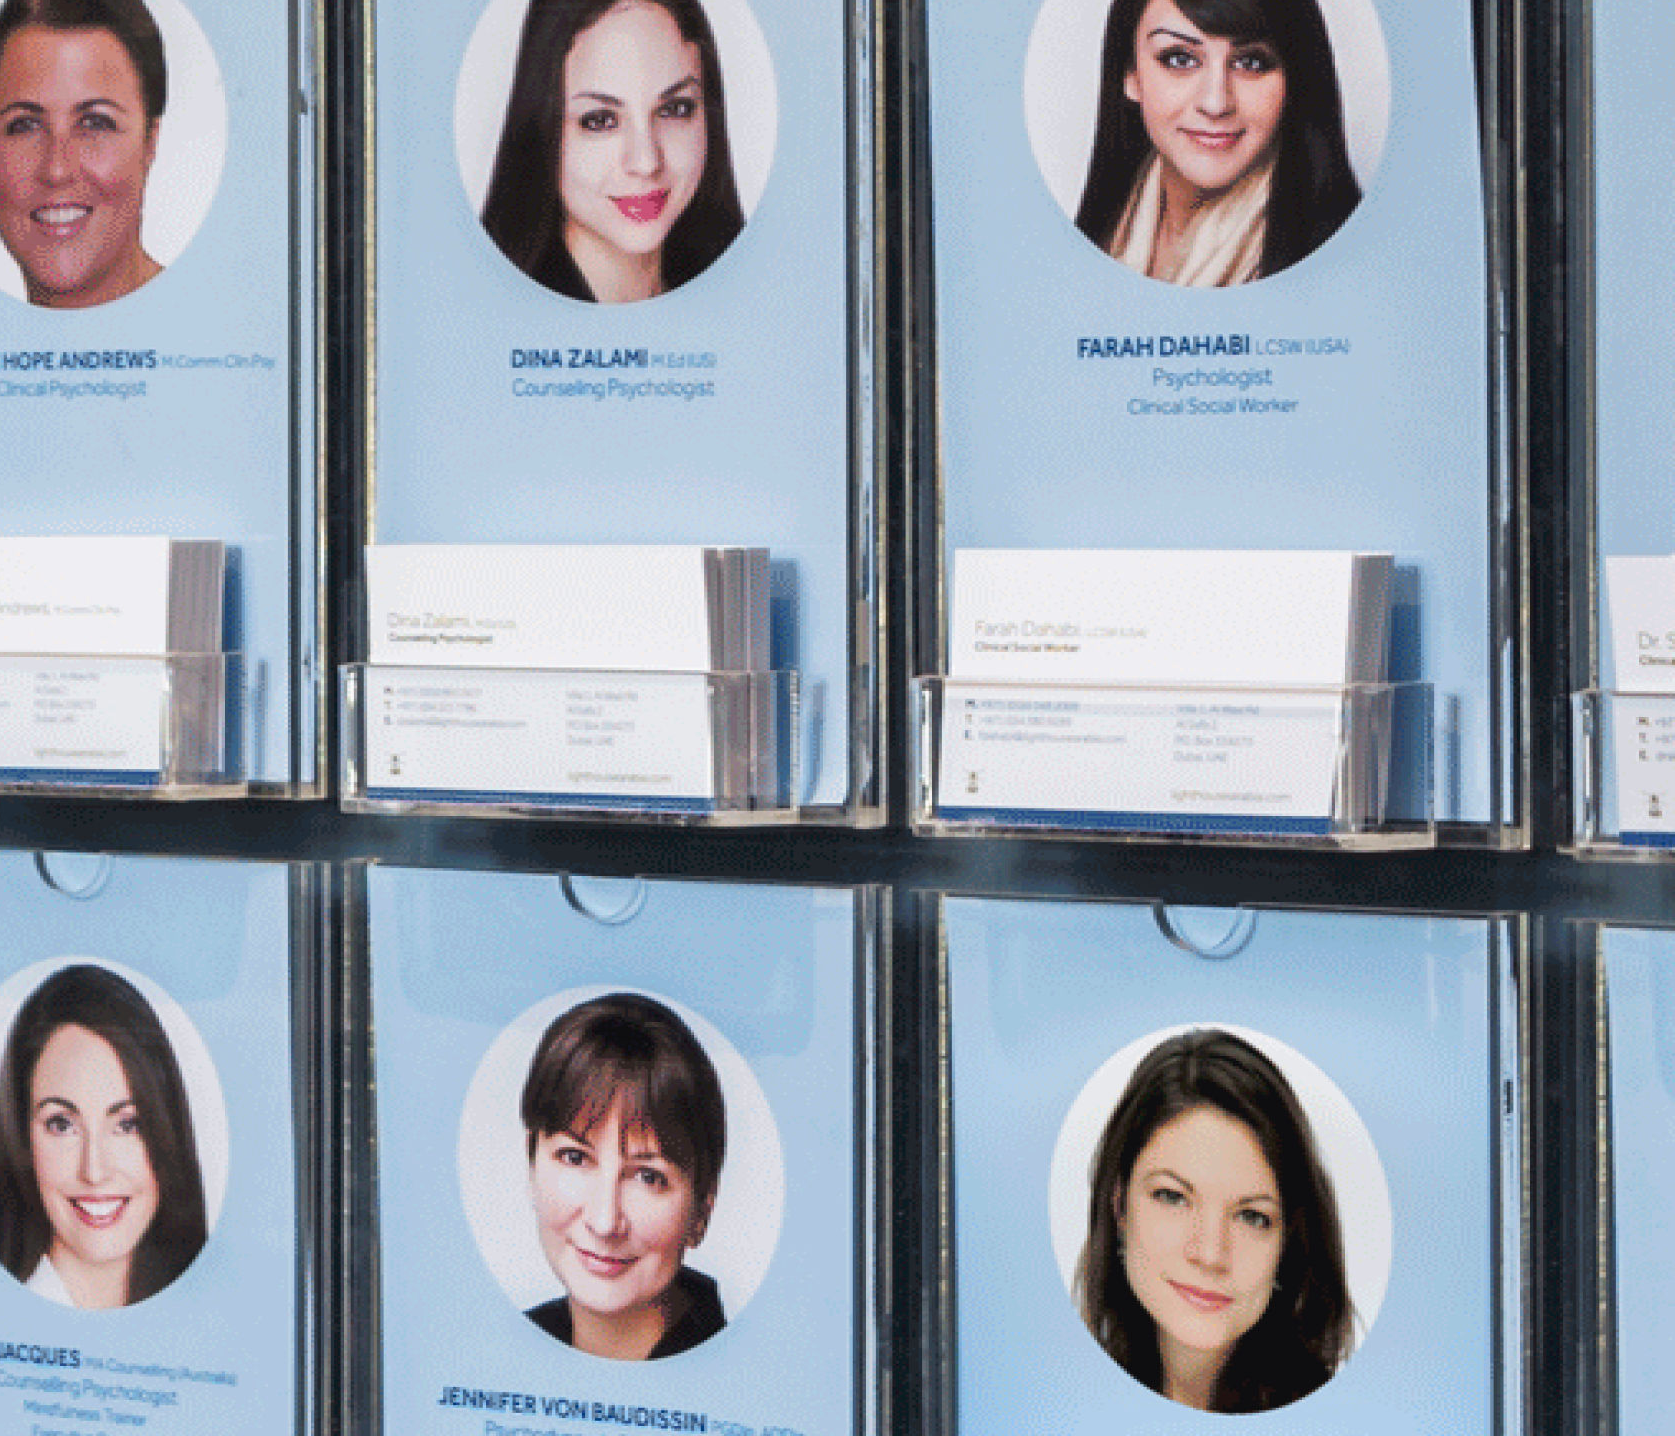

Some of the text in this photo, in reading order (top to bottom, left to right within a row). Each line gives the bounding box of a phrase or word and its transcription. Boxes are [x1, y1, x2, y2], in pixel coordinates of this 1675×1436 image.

[1077, 336, 1154, 358] FARAH
[1159, 334, 1250, 357] DAHABI
[1255, 338, 1302, 355] LCSW
[3, 351, 54, 370] HOPE
[58, 349, 156, 369] ANDREWS
[511, 349, 562, 368] DINA
[568, 349, 648, 368] ZALAMI
[49, 379, 147, 400] Psychologist
[607, 377, 715, 402] Psychologist
[1152, 367, 1273, 391] Psychologist
[1127, 397, 1299, 415] Clinical Social Worker
[82, 1377, 178, 1407] Psychologist
[438, 1386, 536, 1415] JENNIFER
[541, 1396, 588, 1419] VON
[591, 1401, 708, 1434] BAUDISSIN
